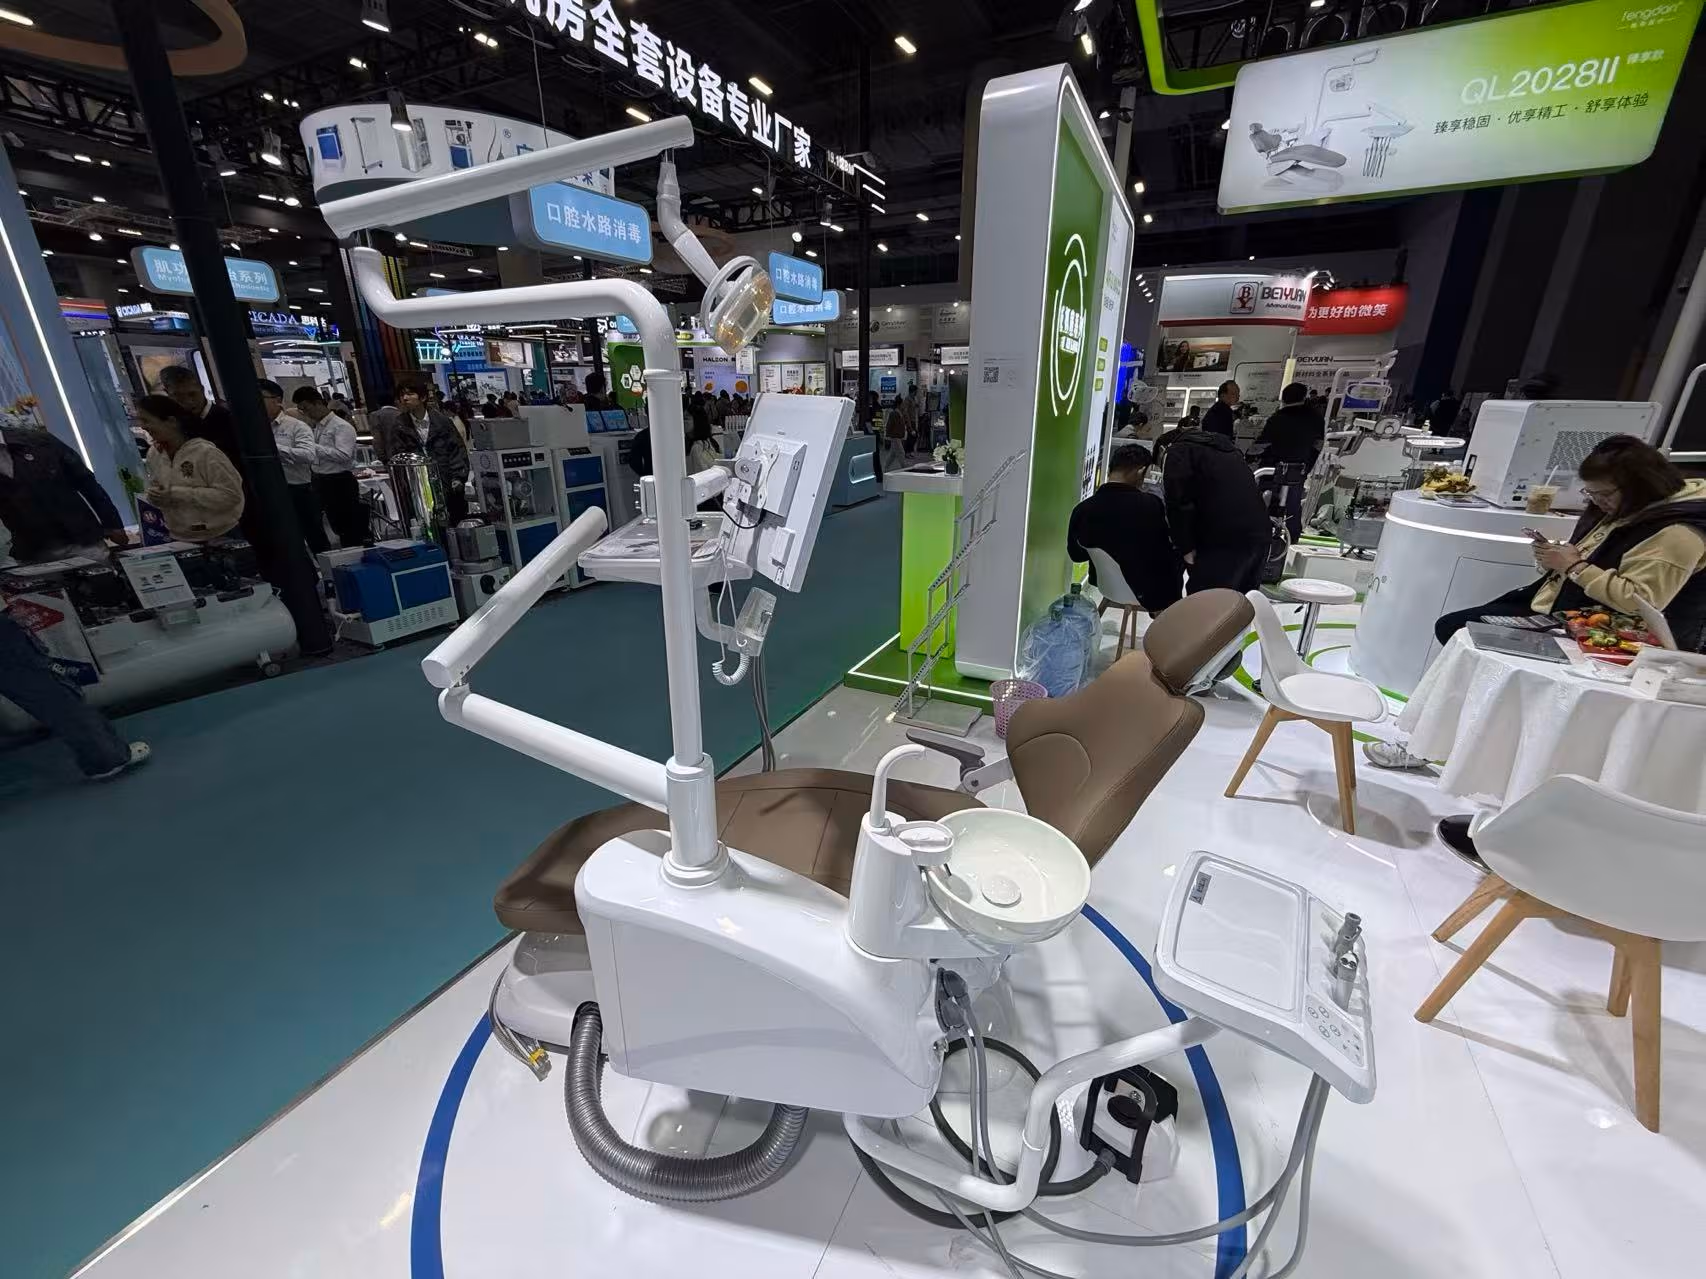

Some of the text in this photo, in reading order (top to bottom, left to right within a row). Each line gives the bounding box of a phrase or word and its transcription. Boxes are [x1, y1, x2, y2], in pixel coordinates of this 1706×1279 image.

[546, 202, 641, 244] 口腔水路消毒
[775, 267, 818, 291] 口腔水路消毒
[248, 311, 299, 325] ICADA
[1308, 304, 1388, 319] 为更好的微笑
